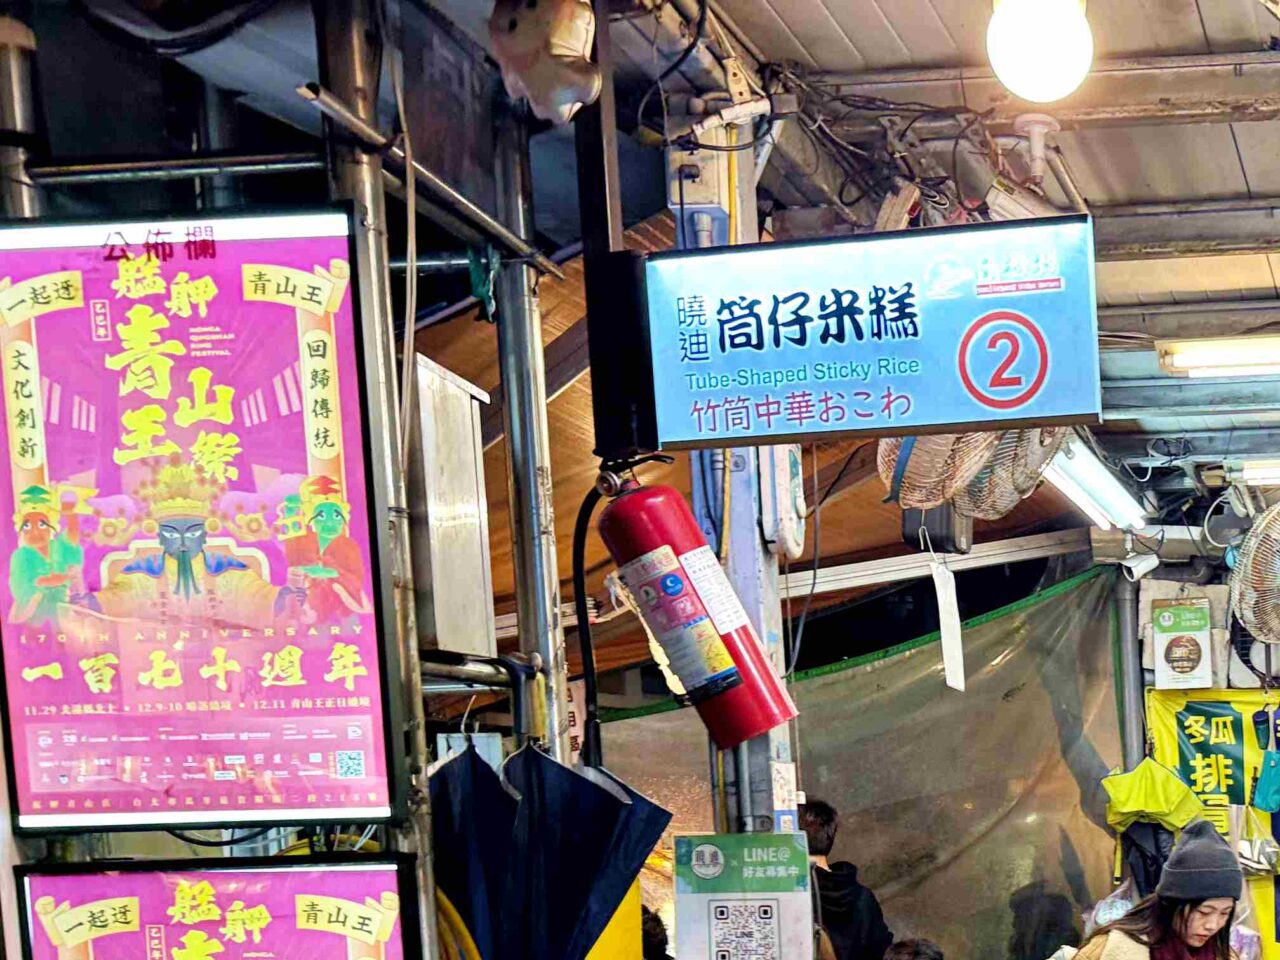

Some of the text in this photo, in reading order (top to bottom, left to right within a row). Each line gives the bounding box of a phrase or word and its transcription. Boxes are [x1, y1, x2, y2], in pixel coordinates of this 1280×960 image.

[247, 271, 325, 306] 青山王
[676, 294, 711, 364] 曉迪
[715, 282, 921, 355] 筒仔米糕
[685, 357, 920, 391] Tube-Shaped Sticky Rice
[986, 331, 1023, 388] 2
[10, 349, 39, 459] 文化創新
[306, 339, 336, 449] 回歸傳統
[690, 385, 912, 434] 竹筒中華おこわ
[134, 625, 364, 641] ANNIVERSARY
[21, 642, 368, 694] 一百七十週年
[743, 848, 791, 862] LINE@
[302, 902, 375, 937] 青山王
